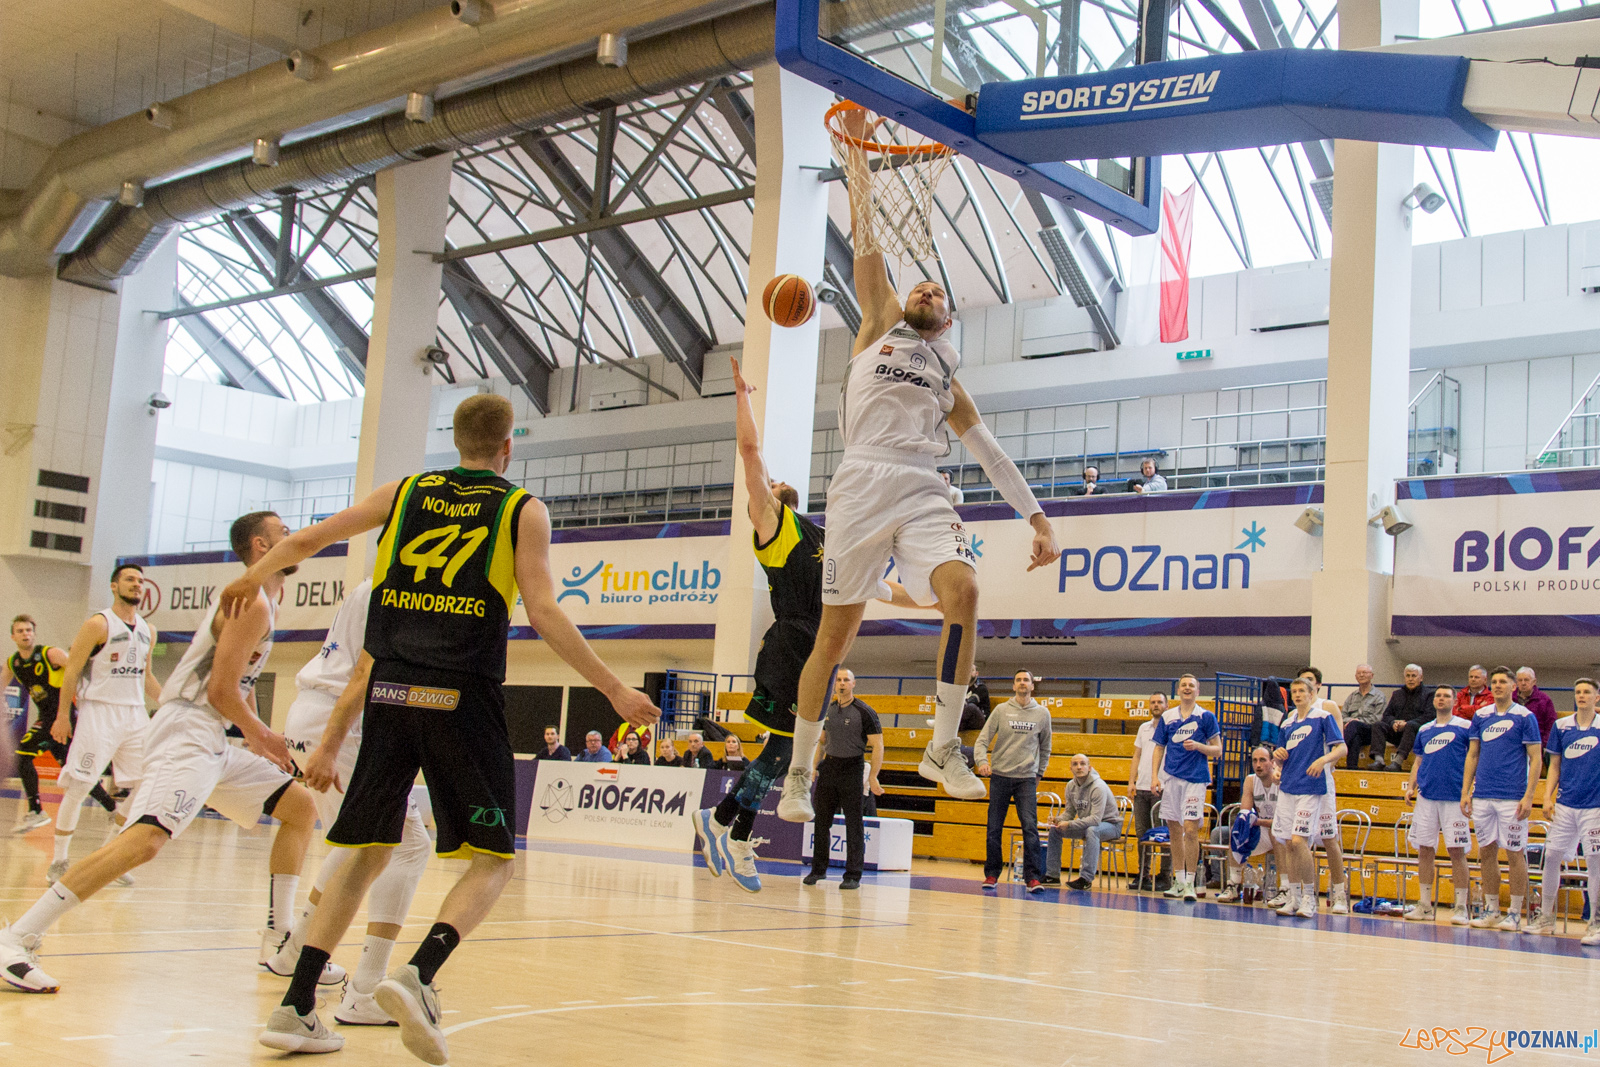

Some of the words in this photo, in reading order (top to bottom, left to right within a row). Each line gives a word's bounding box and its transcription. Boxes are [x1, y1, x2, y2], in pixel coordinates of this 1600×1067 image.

[1021, 85, 1107, 112] SPORT
[1107, 70, 1221, 111] SYSTEM
[909, 353, 927, 371] 9
[422, 496, 482, 518] NOWICKI
[399, 524, 489, 588] 41
[600, 560, 722, 592] funclub
[825, 559, 837, 584] 9
[1473, 581, 1527, 592] POLSKI
[170, 586, 217, 610] DELIK
[381, 588, 486, 618] TARNOBRZEG
[600, 593, 643, 605] biuro
[648, 591, 719, 605] podróży
[126, 647, 137, 664] 6
[34, 662, 44, 676] 0
[408, 689, 455, 706] DŹWIG
[80, 752, 95, 769] 6
[577, 784, 688, 817] BIOFARM
[583, 814, 607, 823] POLSKI
[610, 816, 647, 827] PRODUCENT
[650, 818, 673, 828] LEKÓW
